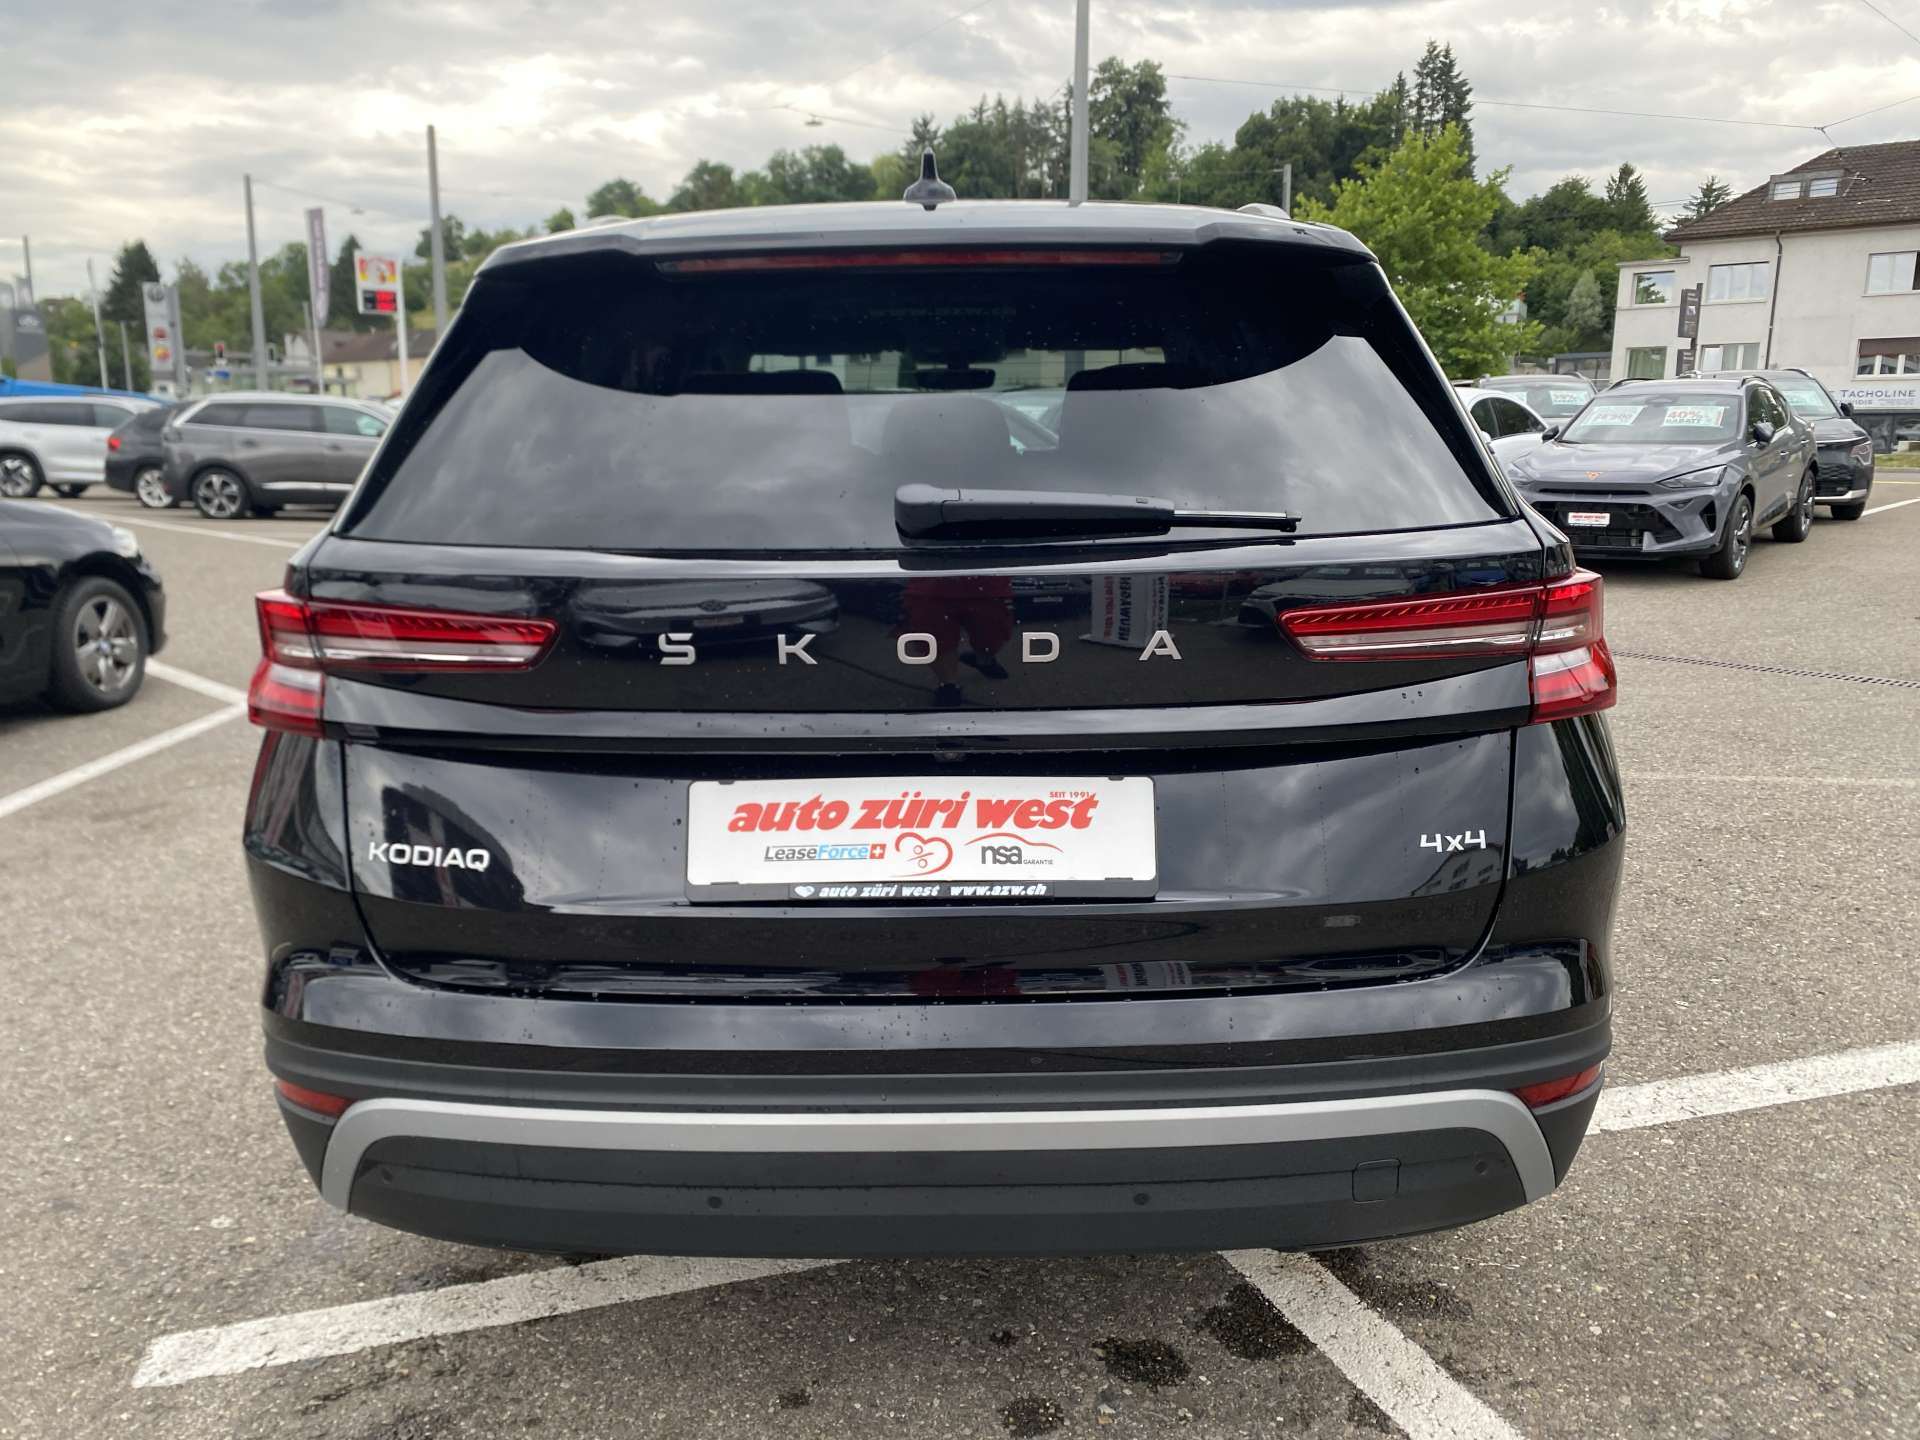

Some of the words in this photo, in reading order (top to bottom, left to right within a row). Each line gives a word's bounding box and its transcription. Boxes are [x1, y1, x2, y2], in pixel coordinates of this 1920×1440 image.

[1840, 388, 1917, 399] TACHOLINE
[658, 630, 1182, 666] SKODA
[1050, 791, 1067, 799] SEIT
[1069, 791, 1091, 799] 1991
[727, 793, 850, 833] auto
[851, 790, 971, 830] züri
[976, 793, 1100, 831] west
[1419, 829, 1487, 853] 4x4
[368, 841, 490, 872] KODIAQ
[764, 844, 869, 861] LeaseForce
[981, 845, 1022, 865] nsa
[818, 884, 858, 898] auto
[860, 883, 898, 898] züri
[902, 884, 940, 897] west
[950, 882, 1048, 897] www.azw.ch
